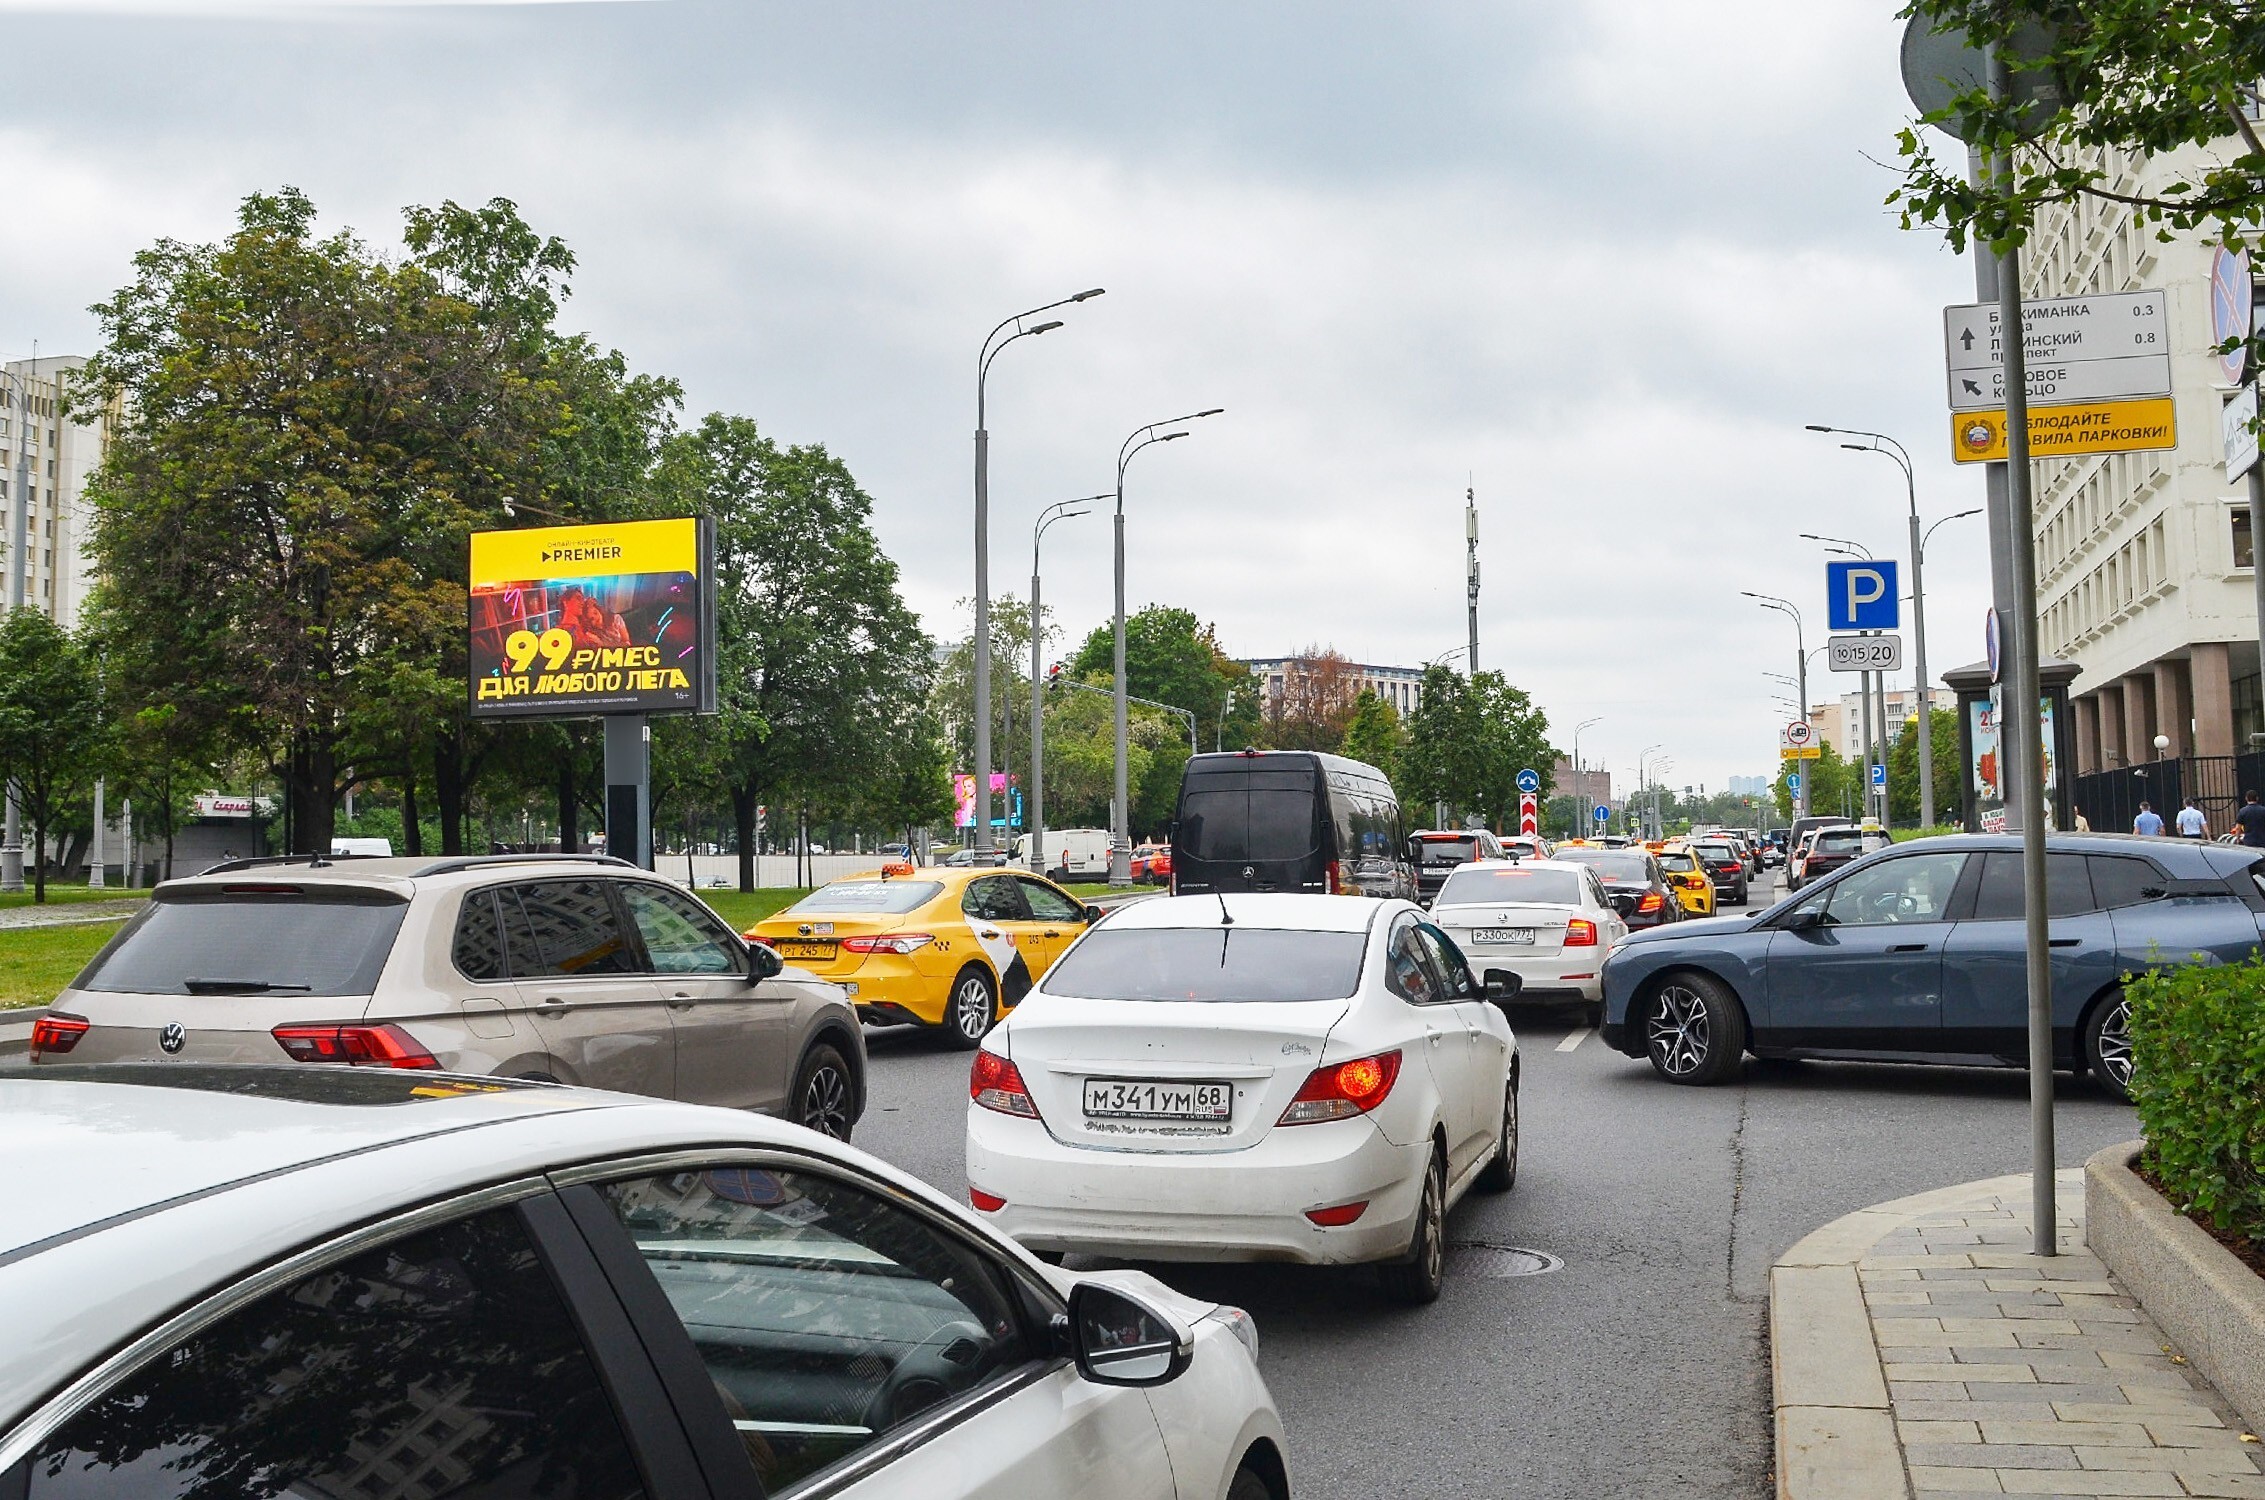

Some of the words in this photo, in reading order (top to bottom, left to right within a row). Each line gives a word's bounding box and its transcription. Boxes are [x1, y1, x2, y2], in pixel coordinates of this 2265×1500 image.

[2021, 305, 2090, 320] КИМАНКА
[2133, 305, 2153, 317] 0.3
[1991, 330, 2082, 350] ЛИНСКИЙ
[2135, 333, 2155, 344] 0.8
[1991, 348, 2057, 363] ппект
[1992, 369, 2067, 385] СОВОЕ
[1993, 383, 2056, 398] КЬЦО
[2001, 411, 2111, 432] СБЛЮДАЙТЕ
[2079, 426, 2168, 443] ПАРКОВКИ!
[554, 546, 621, 562] PREMIER
[1847, 569, 1885, 622] P
[1837, 649, 1848, 659] 10
[1852, 647, 1865, 660] 15
[1871, 646, 1891, 661] 20
[477, 676, 530, 700] ДЛЯ
[533, 671, 622, 694] ЛЮБОГО
[625, 667, 690, 691] ЛЕТА
[800, 945, 818, 956] 245
[1093, 1085, 1191, 1111] М341УМ
[1197, 1087, 1220, 1106] 68
[1195, 1105, 1213, 1114] RUS
